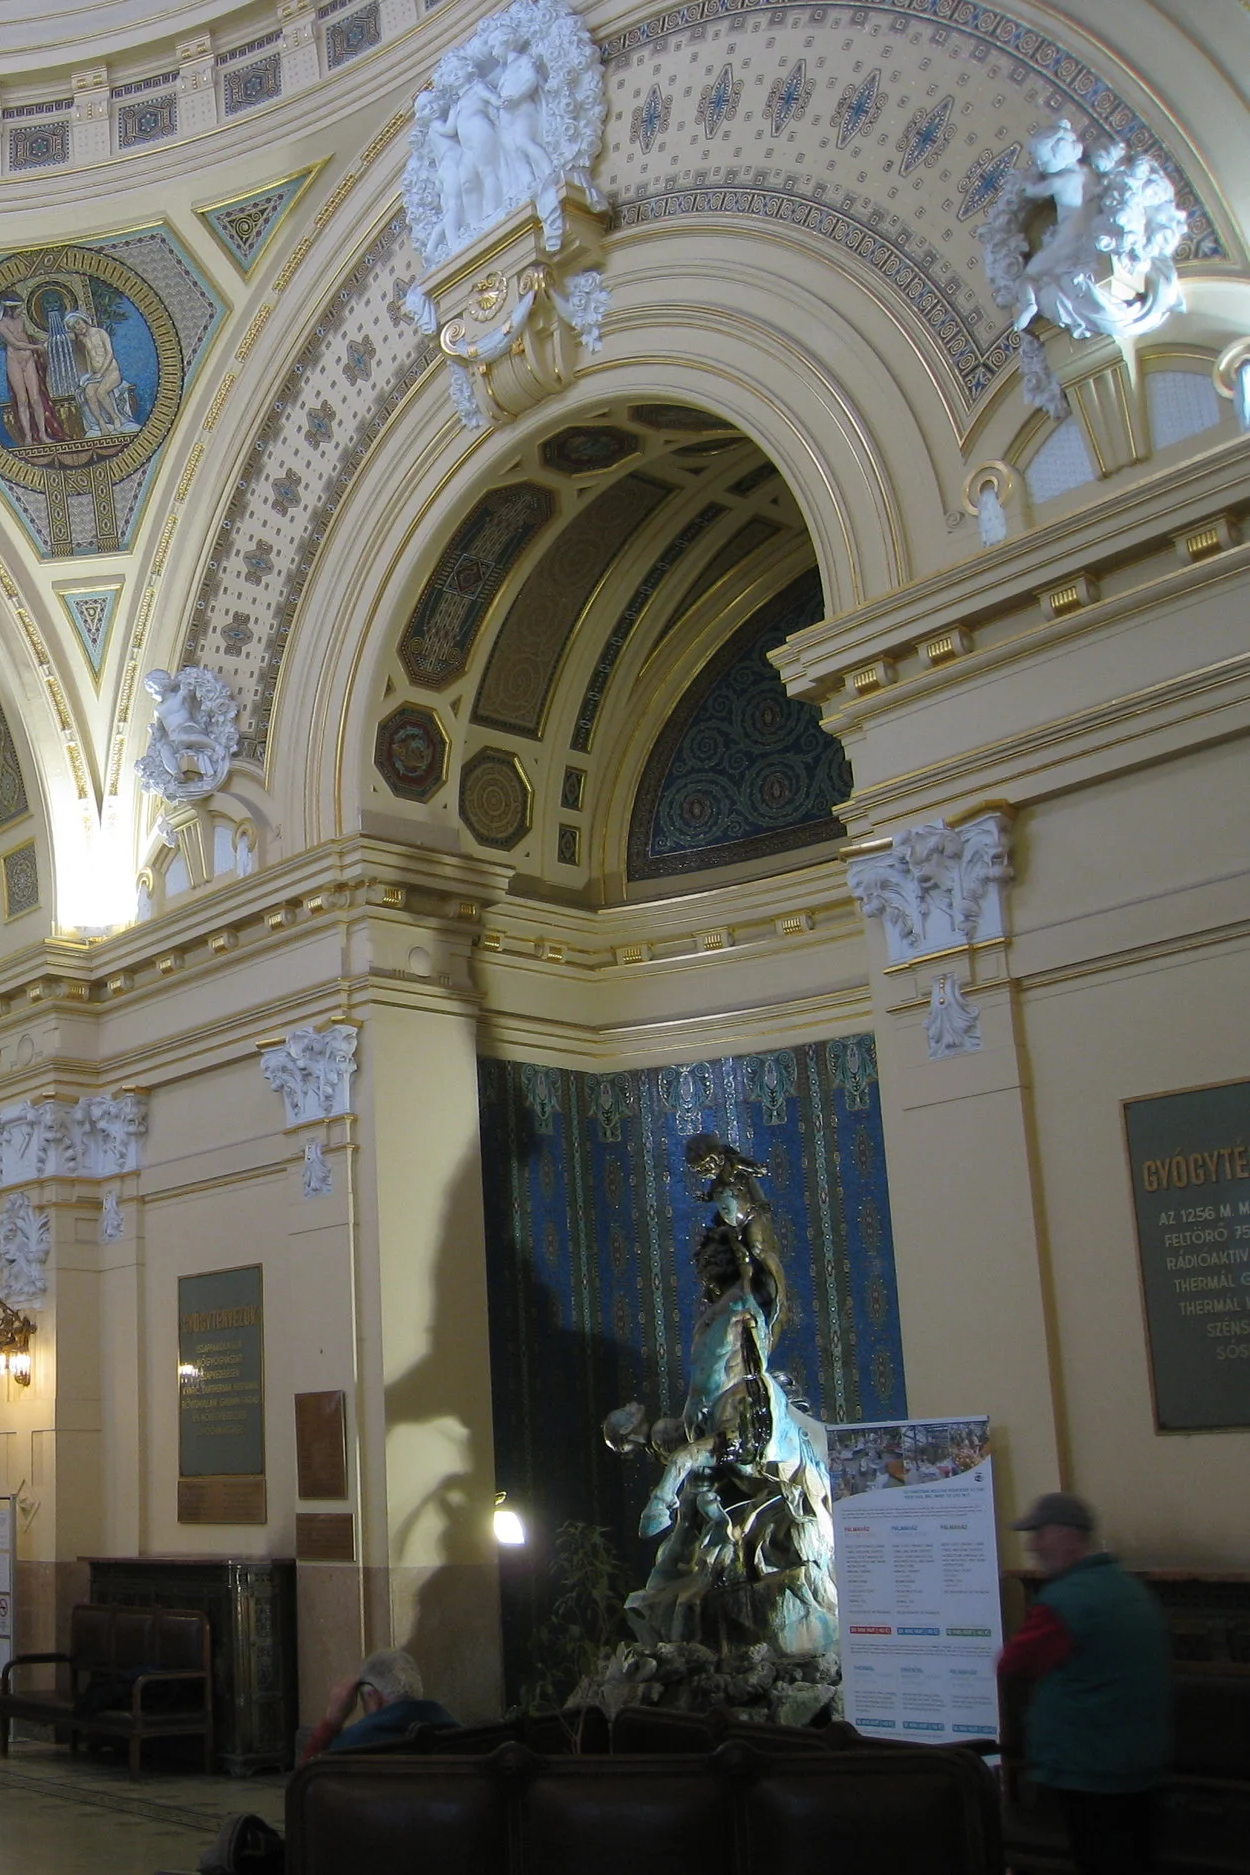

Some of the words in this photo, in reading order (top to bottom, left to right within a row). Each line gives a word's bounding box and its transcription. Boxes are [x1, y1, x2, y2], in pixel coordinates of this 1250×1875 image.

[1142, 1138, 1250, 1192] GYÓGYTÉ
[1159, 1210, 1176, 1226] AZ
[1180, 1205, 1216, 1223] 1256
[1174, 1269, 1236, 1293] THERMÁL
[1178, 1292, 1242, 1316] THERMÁL
[1216, 1340, 1250, 1360] SÓS
